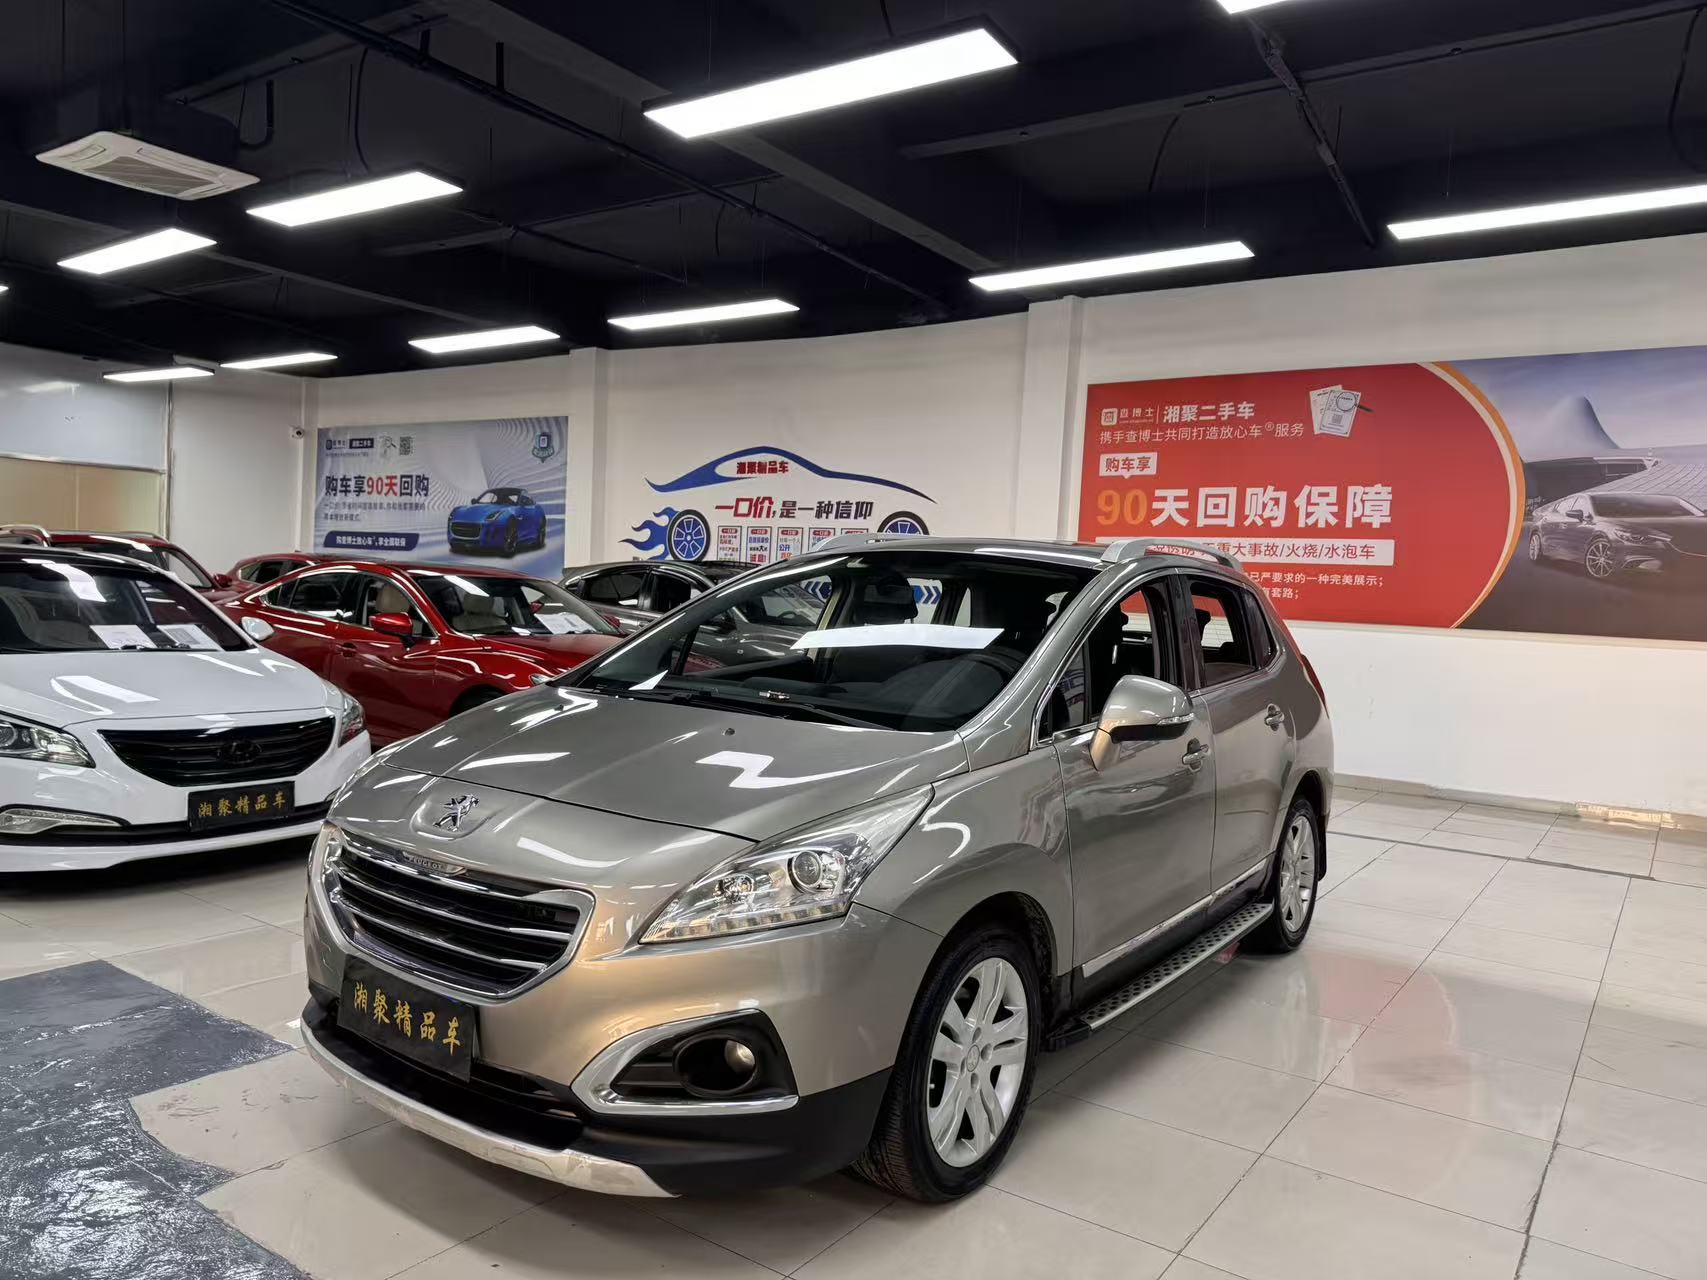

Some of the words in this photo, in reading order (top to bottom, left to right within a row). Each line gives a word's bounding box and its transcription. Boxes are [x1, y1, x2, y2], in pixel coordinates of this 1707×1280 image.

[1163, 401, 1255, 423] 湘聚二手车
[1105, 456, 1151, 473] 购车享
[324, 474, 430, 498] 购车享90天回购
[1096, 484, 1392, 529] 90天回购保障
[198, 790, 286, 817] 湘聚精品车
[353, 981, 461, 1056] 湘聚精品车
